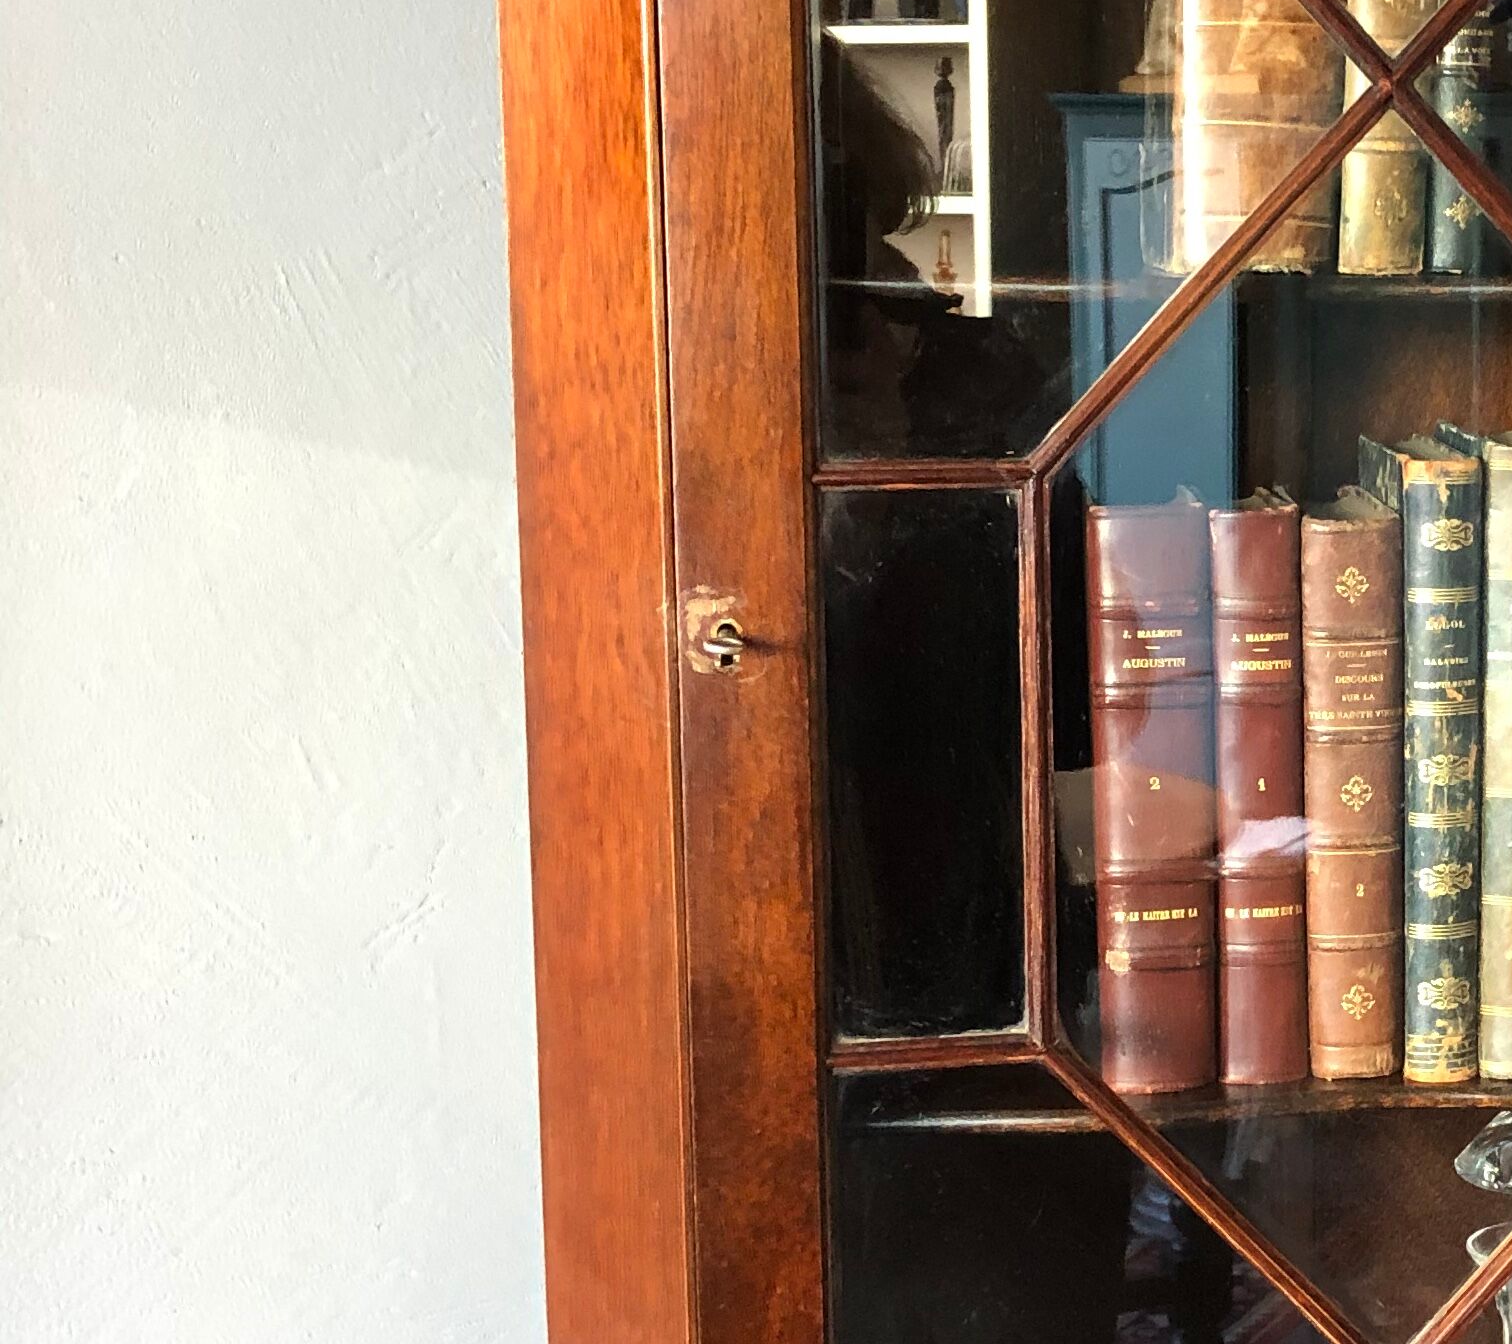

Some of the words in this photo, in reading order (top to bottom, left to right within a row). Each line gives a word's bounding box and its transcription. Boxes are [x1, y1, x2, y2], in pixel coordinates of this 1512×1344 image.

[1122, 658, 1186, 670] AUGUSTIN
[1230, 659, 1292, 671] AUGUSTIN
[1149, 776, 1161, 791] 2
[1257, 777, 1267, 792] 1
[1356, 883, 1365, 897] 2
